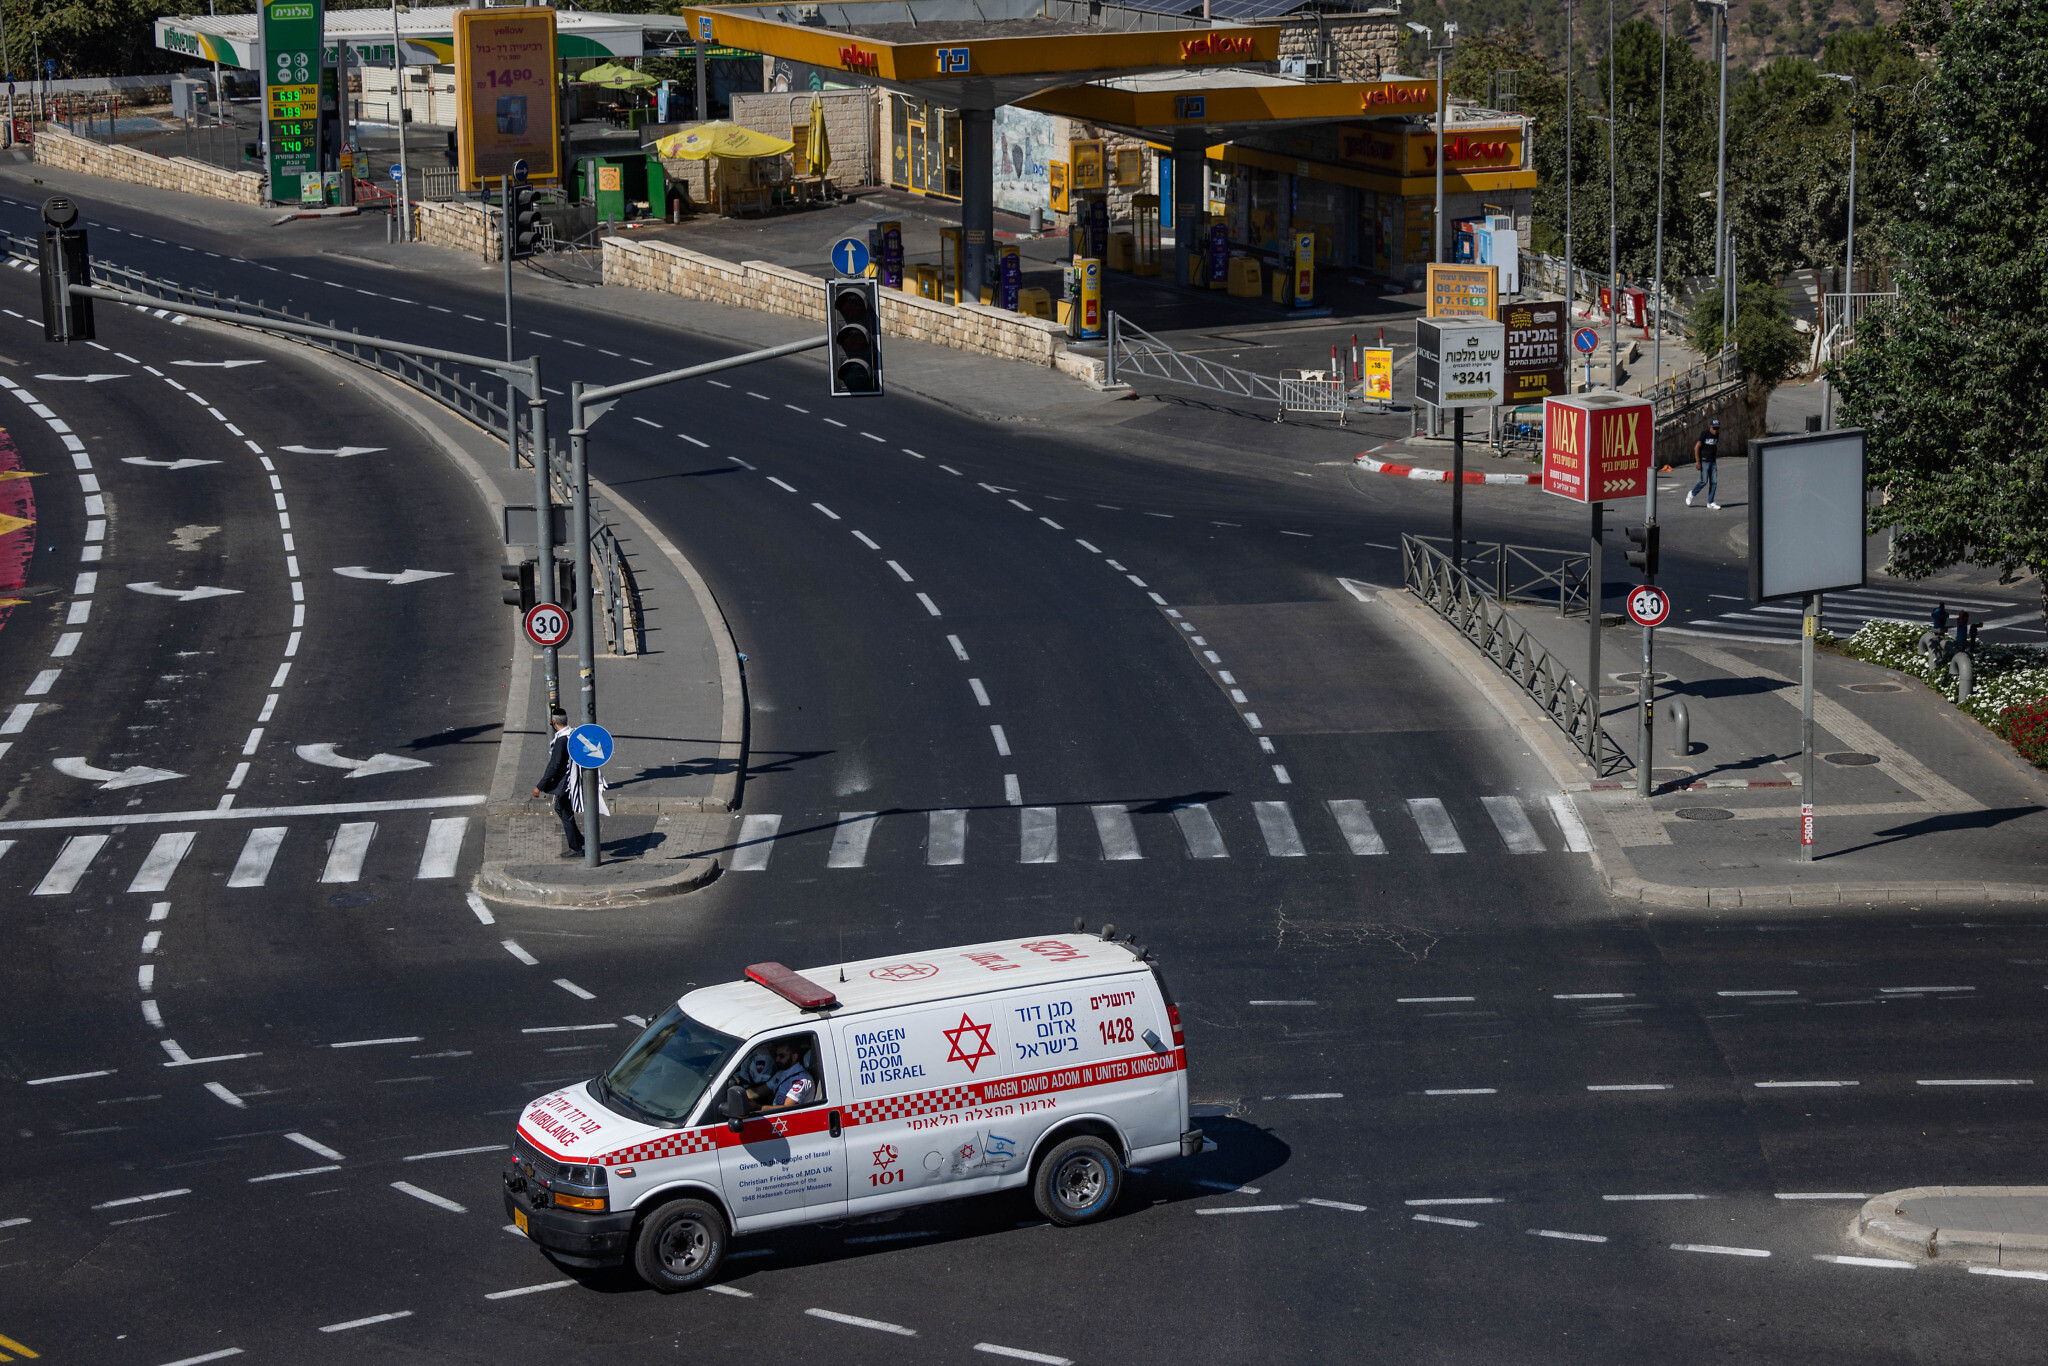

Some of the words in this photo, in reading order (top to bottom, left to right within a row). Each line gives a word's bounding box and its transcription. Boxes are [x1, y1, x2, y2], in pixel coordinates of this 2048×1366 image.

[275, 6, 309, 17] אלונית
[494, 26, 524, 36] yellow
[1180, 33, 1254, 59] yellow
[838, 44, 874, 68] yellow
[938, 48, 970, 73] פז
[280, 91, 300, 101] 6.99
[1361, 84, 1429, 110] yellow
[300, 102, 316, 111] סולר
[281, 124, 300, 136] 7.16
[303, 121, 314, 130] 95
[281, 142, 302, 152] 7.40
[304, 138, 314, 147] 95
[1424, 137, 1508, 167] yellow
[1436, 283, 1468, 293] 08.47
[1470, 285, 1487, 293] סולר
[1436, 296, 1469, 305] 07.16
[1472, 298, 1485, 306] 95
[1439, 307, 1454, 315] מלא
[1509, 328, 1557, 343] המכירה
[1445, 348, 1476, 363] מלכות
[1479, 349, 1500, 361] שיש
[1510, 343, 1557, 358] הגדולה
[1520, 375, 1547, 388] חניה
[1552, 407, 1578, 456] MAX
[1602, 412, 1639, 459] MAX
[1614, 460, 1629, 472] קונים
[1629, 458, 1639, 470] כאן
[1636, 598, 1660, 615] 30
[535, 616, 561, 634] 30
[1090, 990, 1136, 1010] ירושלים
[1015, 1006, 1041, 1023] דוד
[1046, 1000, 1073, 1021] מגן
[1037, 1019, 1076, 1038] אדום
[1099, 1017, 1135, 1045] 1428
[855, 1028, 906, 1047] MAGEN
[857, 1042, 901, 1060] DAVID
[1016, 1035, 1078, 1060] בישראל
[860, 1055, 903, 1072] ADOM
[861, 1072, 876, 1085] IN
[881, 1065, 926, 1082] ISRAEL
[984, 1082, 1019, 1100] MAGEN
[1021, 1076, 1049, 1094] DAVID
[1051, 1072, 1080, 1089] ADOM
[1083, 1069, 1093, 1083] IN
[1095, 1064, 1129, 1081] UNITED
[1131, 1057, 1174, 1076] KINGDOM
[546, 1096, 573, 1113] אדום
[965, 1103, 1014, 1122] ההצלה
[1019, 1097, 1057, 1117] ארגון
[564, 1108, 587, 1123] דוד
[907, 1113, 959, 1131] הלאומי
[526, 1108, 580, 1147] AMBULANCE
[579, 1119, 602, 1135] מגן
[782, 1155, 802, 1165] people
[813, 1150, 831, 1158] Israel
[739, 1177, 768, 1188] Christian
[770, 1172, 794, 1182] Friends
[804, 1168, 821, 1177] MDA
[762, 1180, 799, 1191] remembrance
[869, 1169, 904, 1187] 101
[756, 1191, 783, 1200] Hadassah
[784, 1187, 805, 1196] Convoy
[806, 1183, 832, 1191] Massacre
